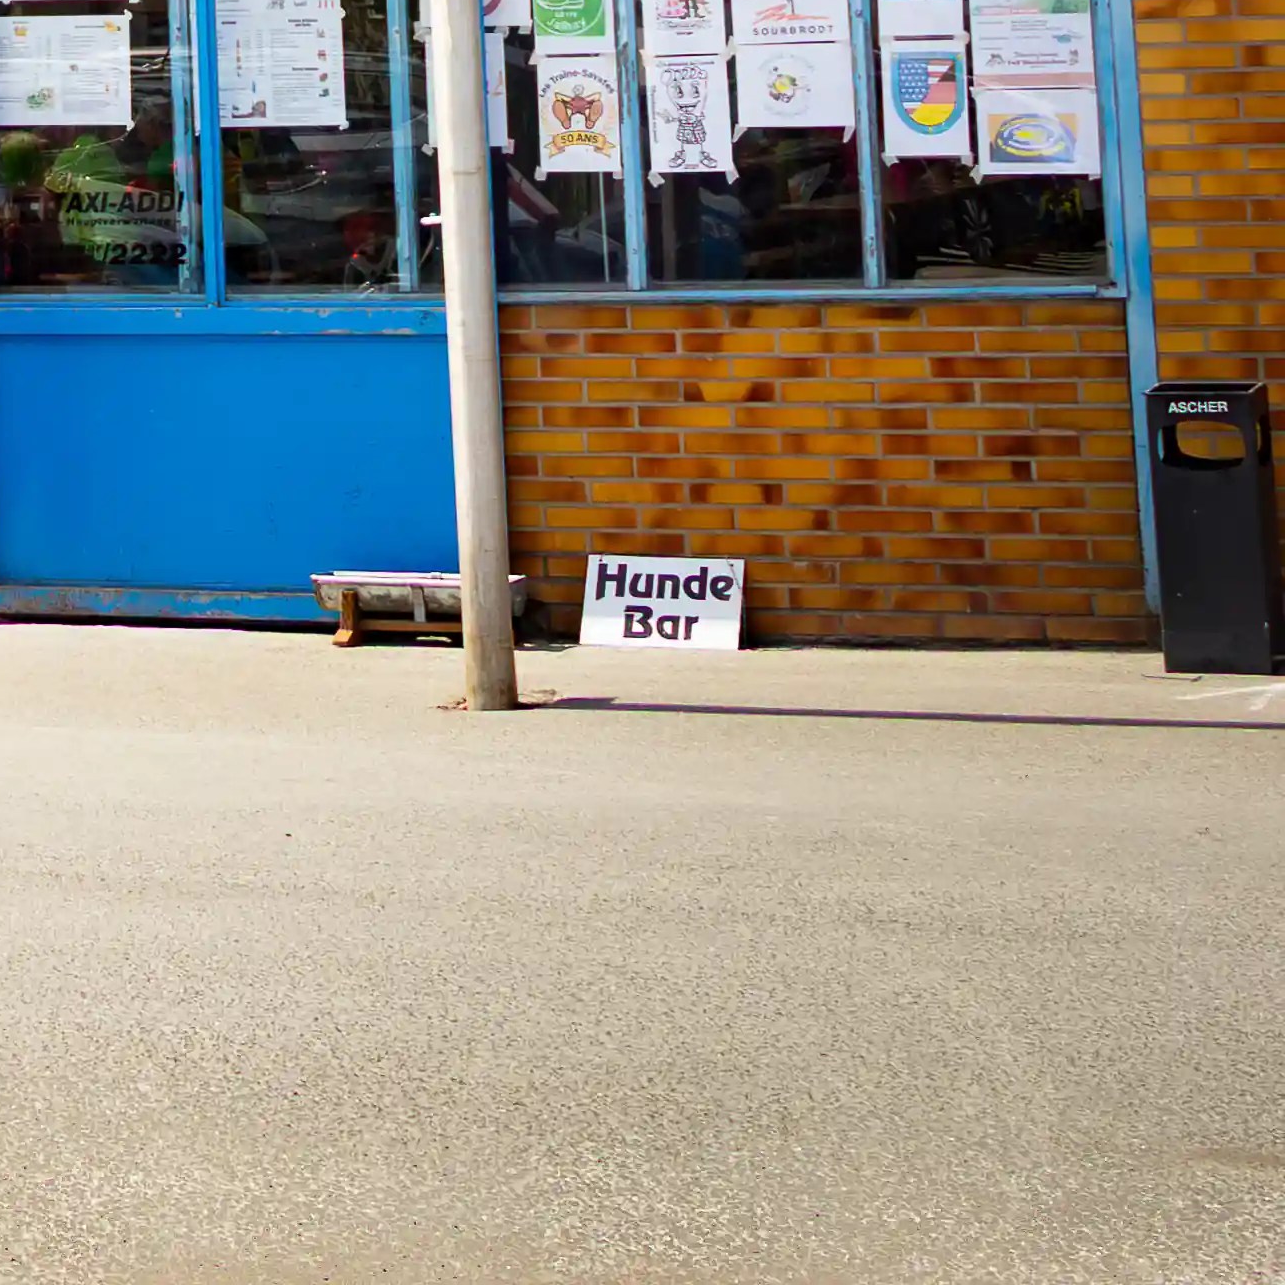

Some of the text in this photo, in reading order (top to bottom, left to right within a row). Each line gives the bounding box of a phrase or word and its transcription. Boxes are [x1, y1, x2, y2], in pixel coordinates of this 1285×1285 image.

[752, 25, 834, 36] SOURBRODT
[560, 133, 598, 144] 50 ANS
[1168, 401, 1229, 414] ASCHER
[595, 563, 735, 602] Hunde
[622, 605, 700, 641] Bar
